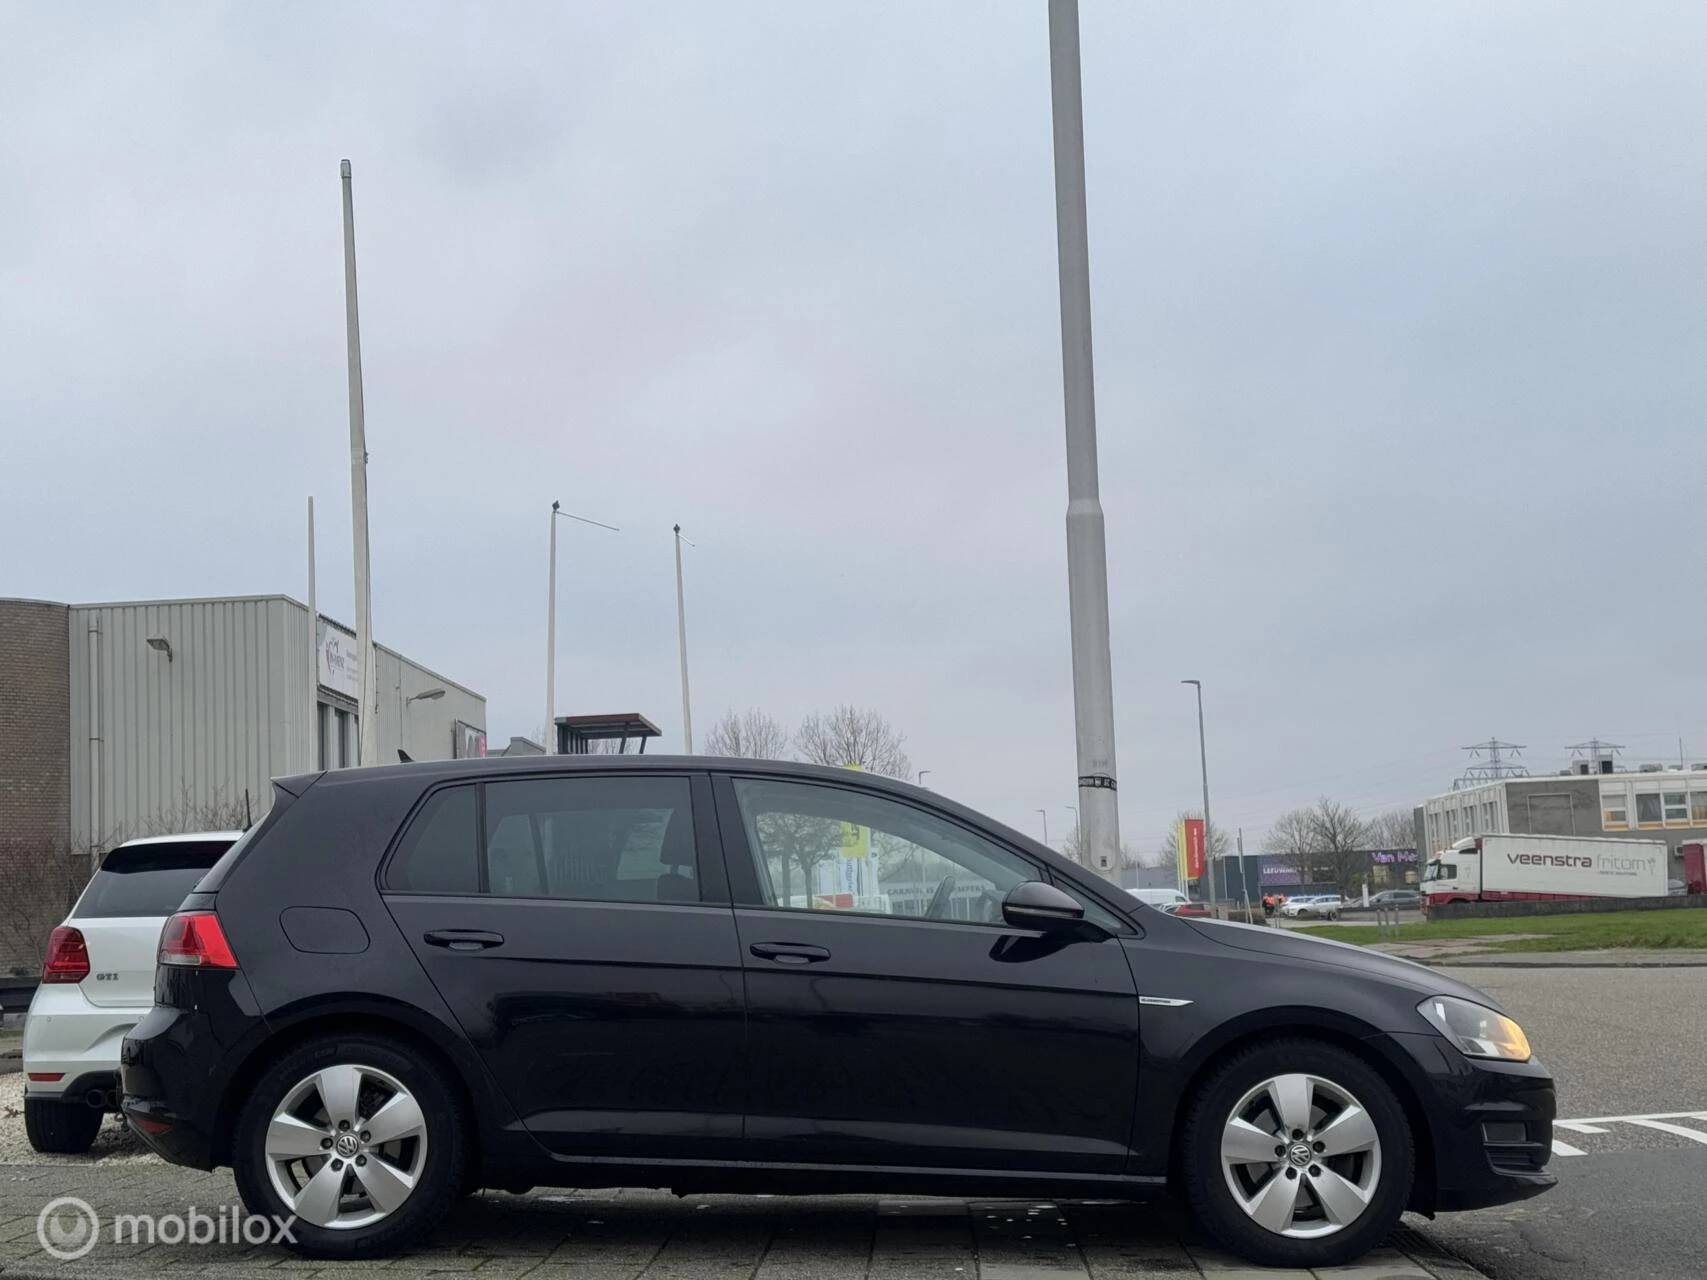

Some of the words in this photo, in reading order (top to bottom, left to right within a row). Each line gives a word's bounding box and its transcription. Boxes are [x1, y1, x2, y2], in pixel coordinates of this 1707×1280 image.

[1506, 853, 1592, 868] veenstra
[1597, 854, 1646, 871] fritom
[96, 972, 119, 981] GTI
